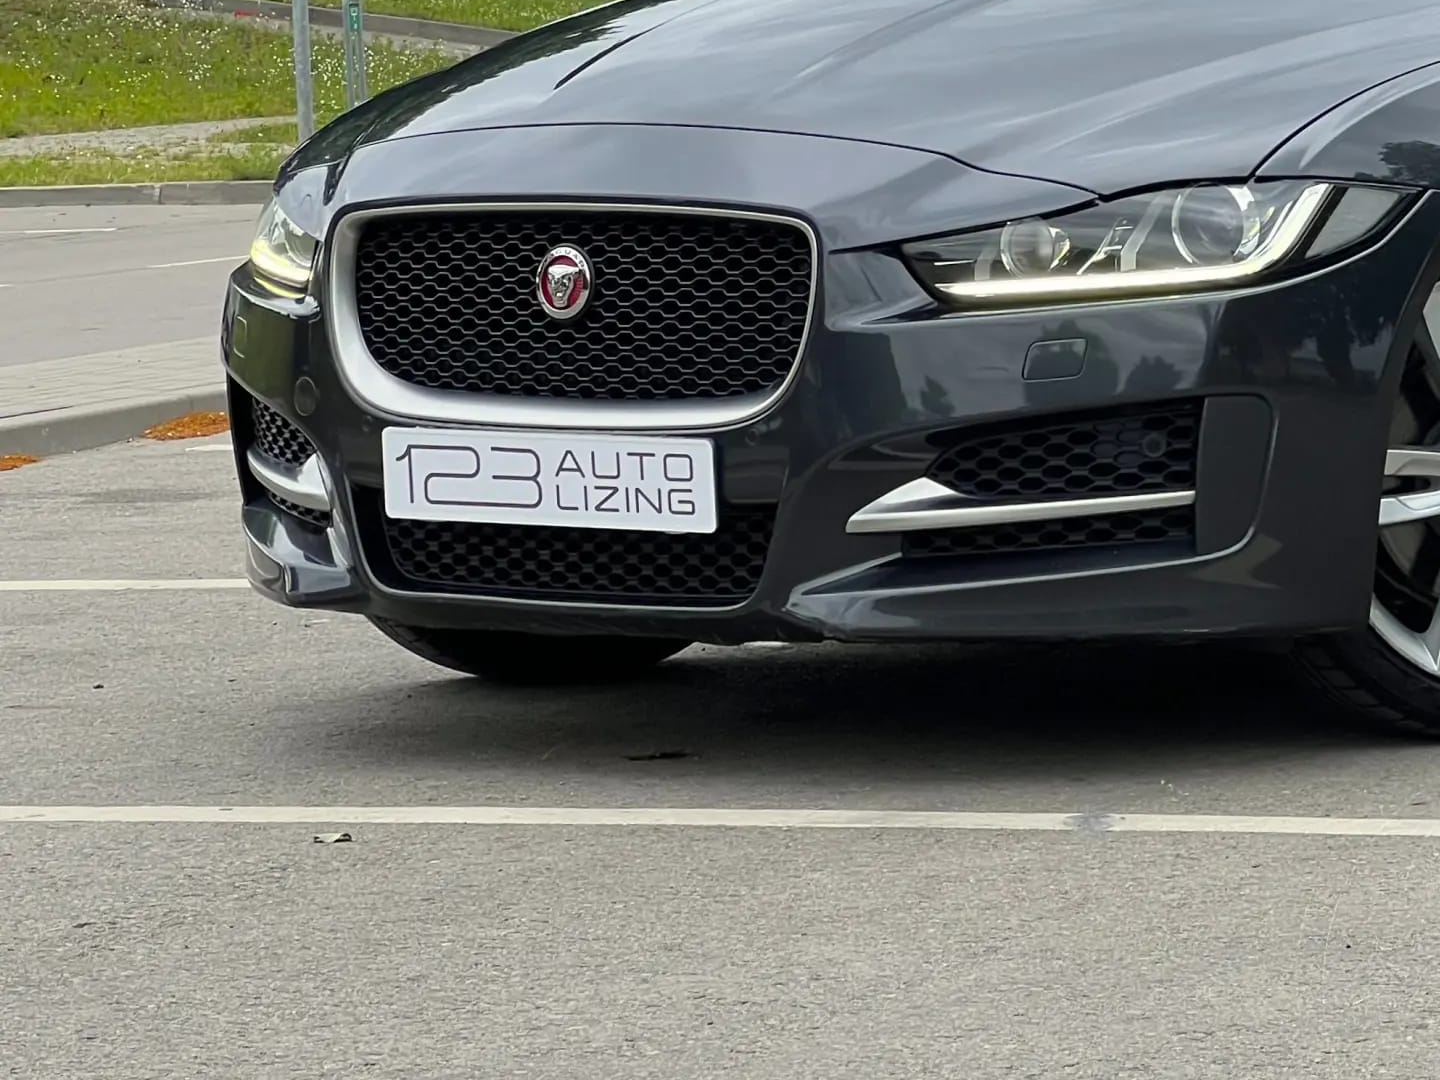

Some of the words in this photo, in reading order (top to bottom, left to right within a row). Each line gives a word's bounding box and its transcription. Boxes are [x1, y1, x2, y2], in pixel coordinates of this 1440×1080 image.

[395, 443, 543, 509] 123
[555, 449, 694, 482] AUTO
[555, 483, 696, 516] LIZING
